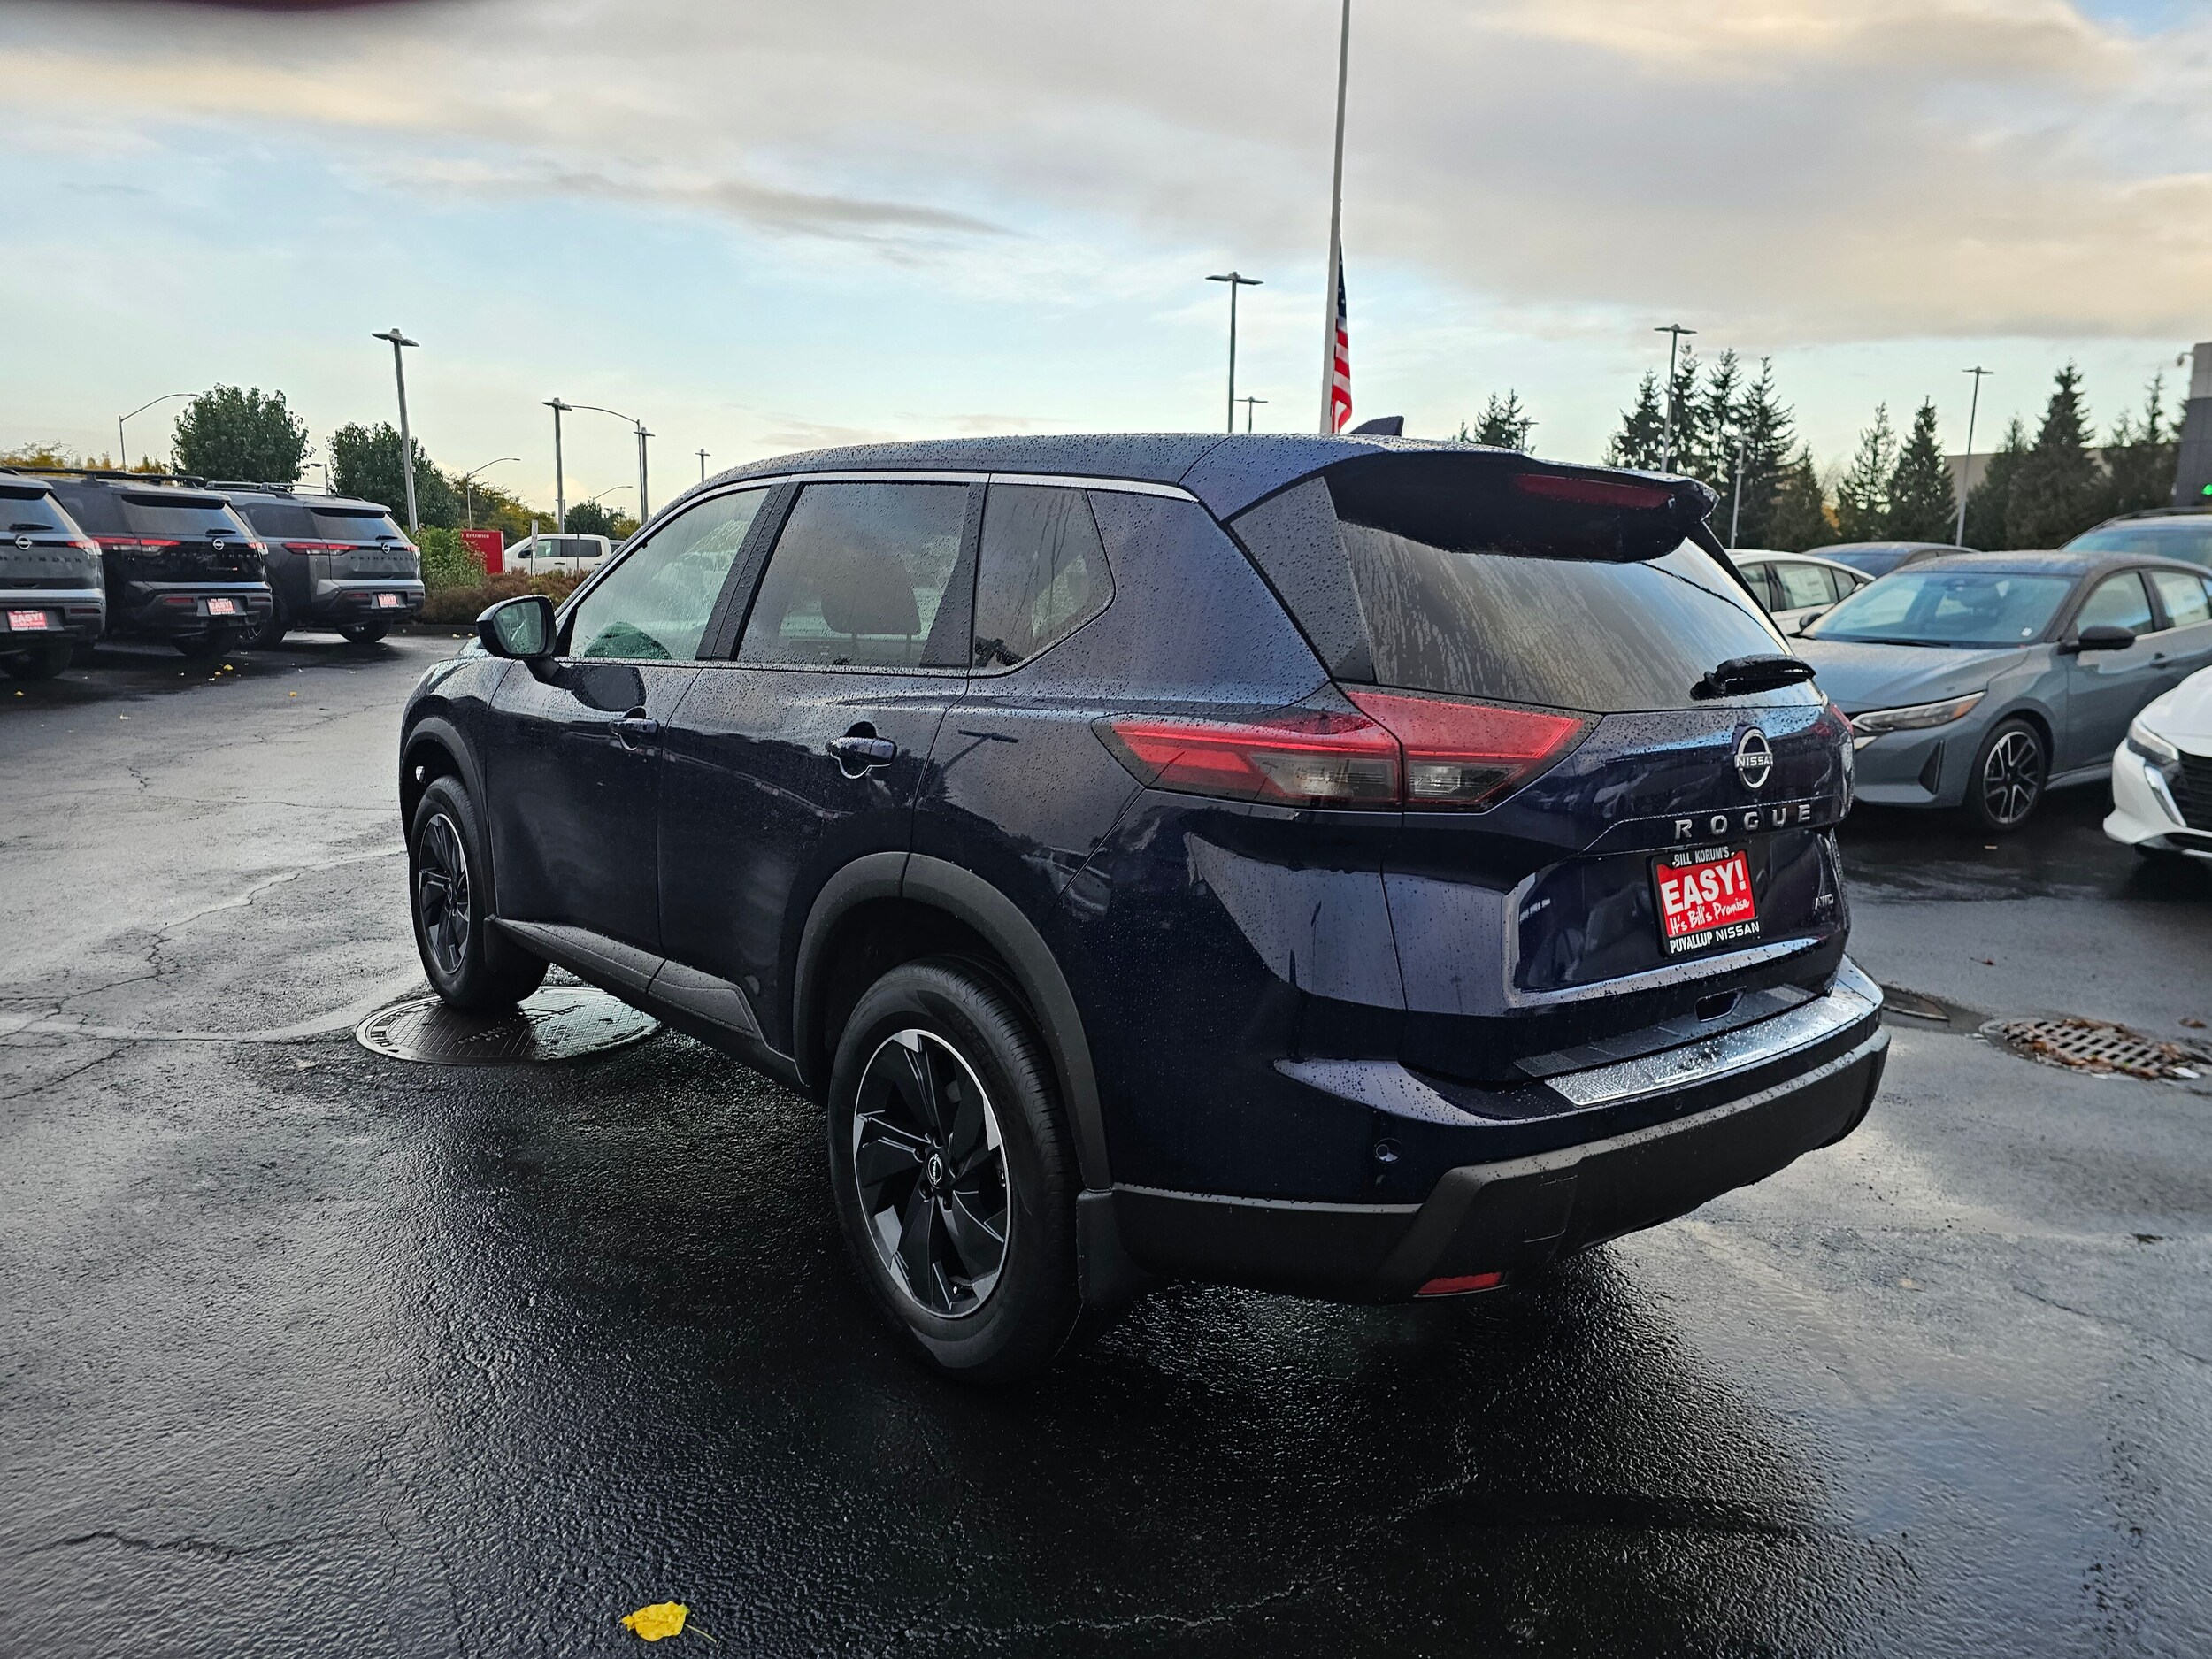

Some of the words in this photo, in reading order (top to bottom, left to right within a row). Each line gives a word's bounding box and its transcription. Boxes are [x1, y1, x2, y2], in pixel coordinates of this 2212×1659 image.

[1674, 803, 1811, 840] ROGUE
[1673, 853, 1692, 868] BILL
[1695, 846, 1730, 864] KORUM'S
[1660, 858, 1747, 917] EASY!
[1669, 914, 1688, 935] It's
[1687, 904, 1713, 929] Bill's
[1712, 897, 1750, 921] Promise
[1669, 931, 1713, 954] PUYALLUP
[1716, 920, 1760, 942] NISSAN
